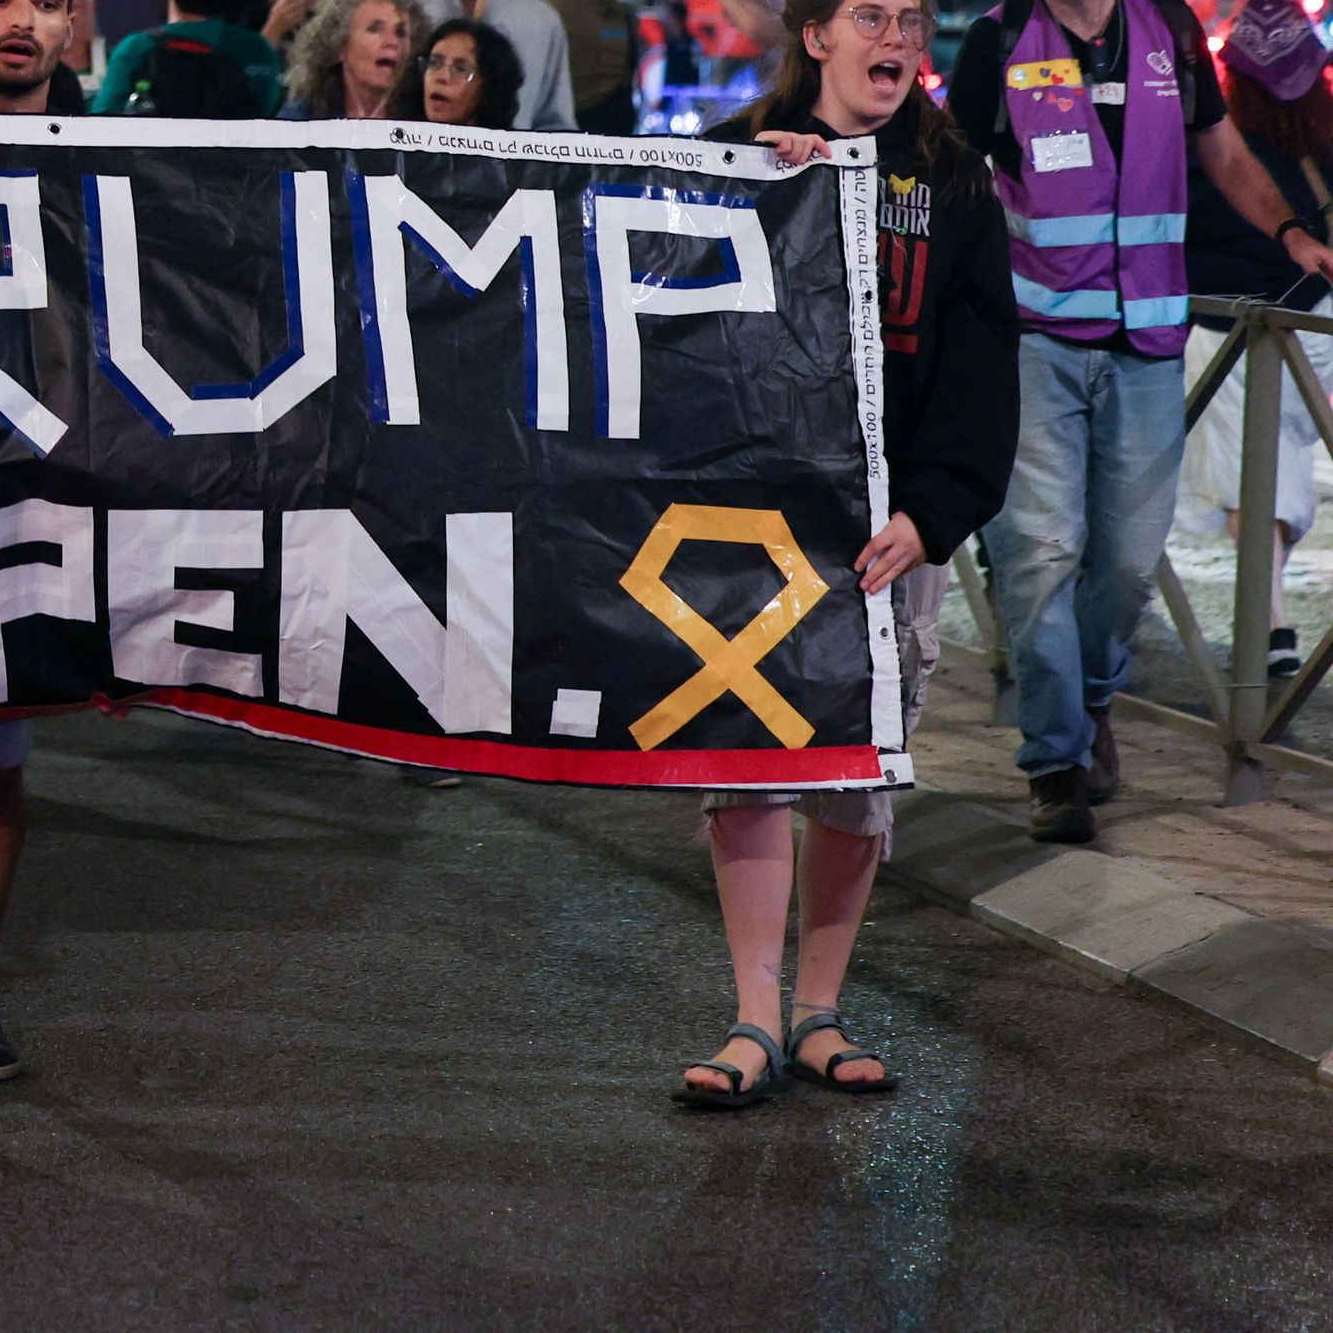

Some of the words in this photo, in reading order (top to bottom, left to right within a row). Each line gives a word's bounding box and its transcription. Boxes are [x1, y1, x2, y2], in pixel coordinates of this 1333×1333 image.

[438, 135, 495, 153] מנצחים
[498, 139, 520, 156] רק
[521, 141, 571, 160] שכולם
[574, 147, 626, 161] חוזרים
[638, 150, 703, 168] 500x100
[855, 209, 869, 266] מנצחים
[879, 203, 931, 237] אותם
[864, 345, 876, 395] חוזרים
[866, 412, 881, 479] 500x100
